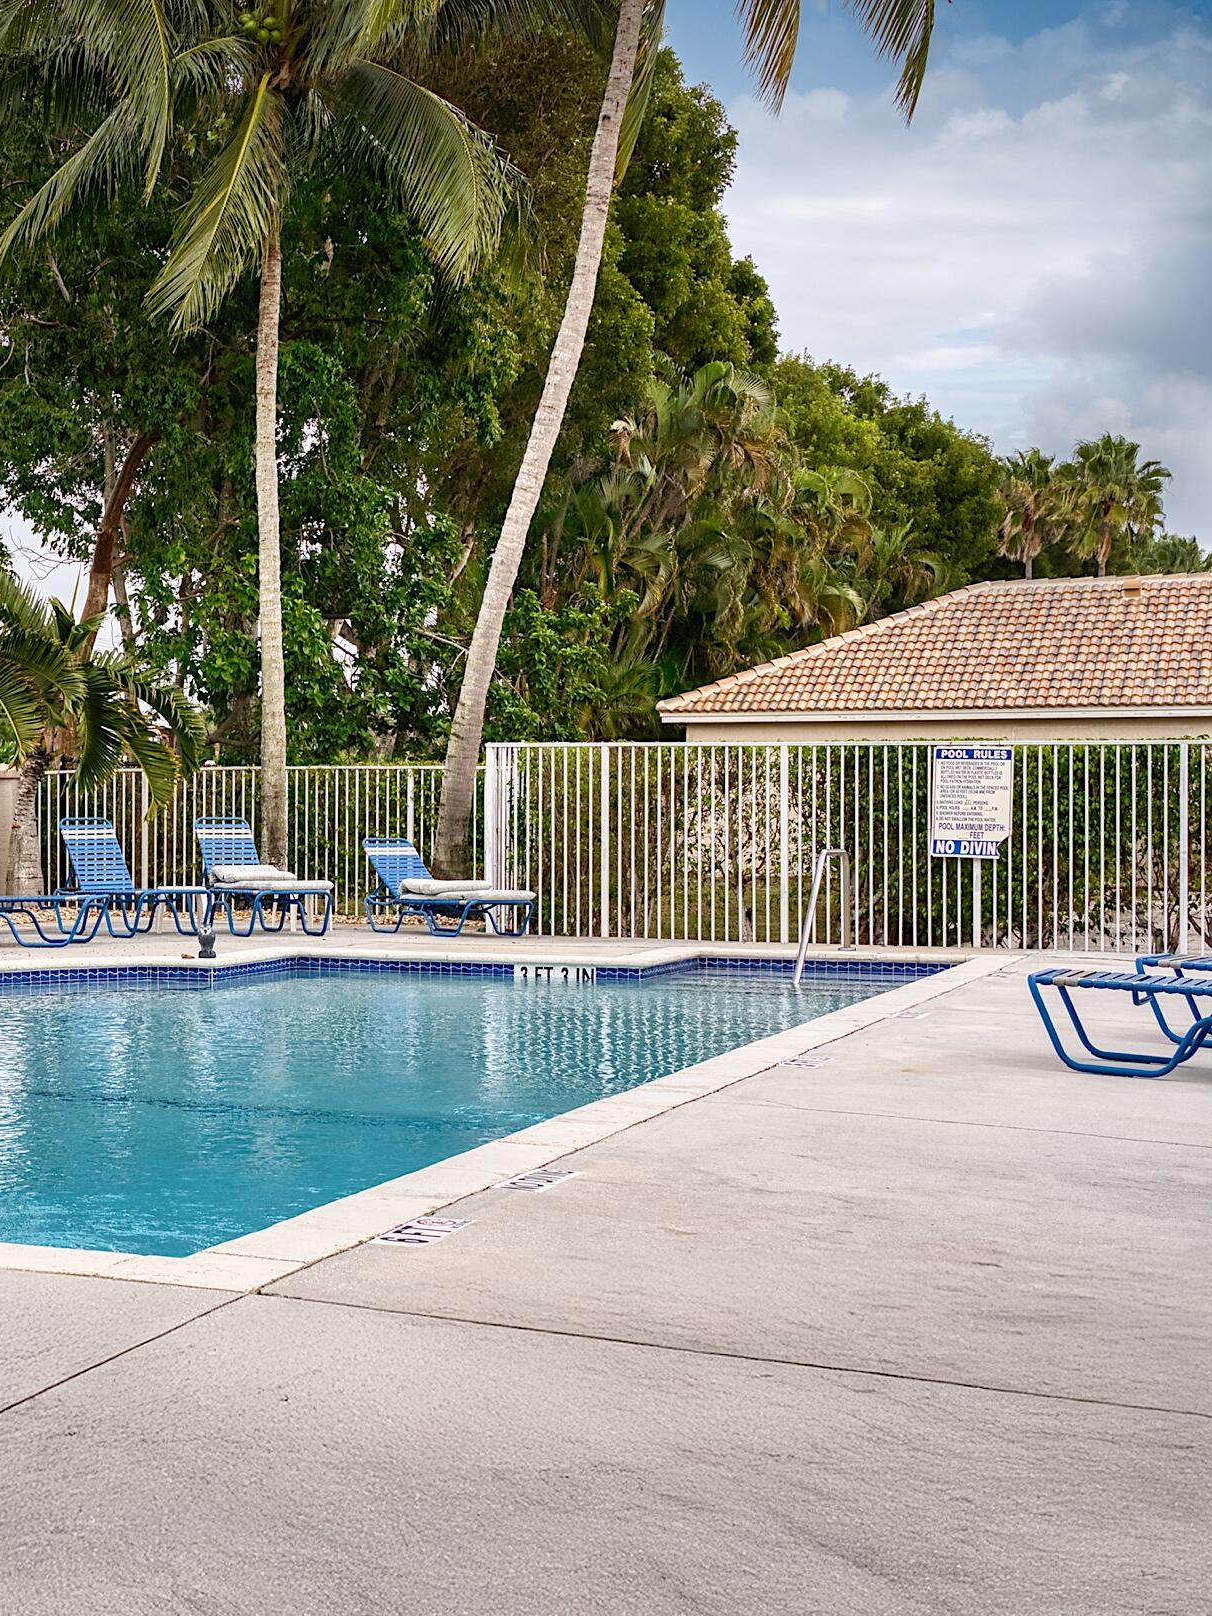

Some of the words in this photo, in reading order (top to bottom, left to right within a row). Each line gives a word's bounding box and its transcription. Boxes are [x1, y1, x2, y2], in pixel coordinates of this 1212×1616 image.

[941, 750, 968, 758] POOL
[974, 750, 1007, 758] RULES
[936, 840, 955, 854] NO
[535, 966, 554, 981] FT
[576, 967, 594, 983] IN
[392, 1225, 452, 1238] FT
